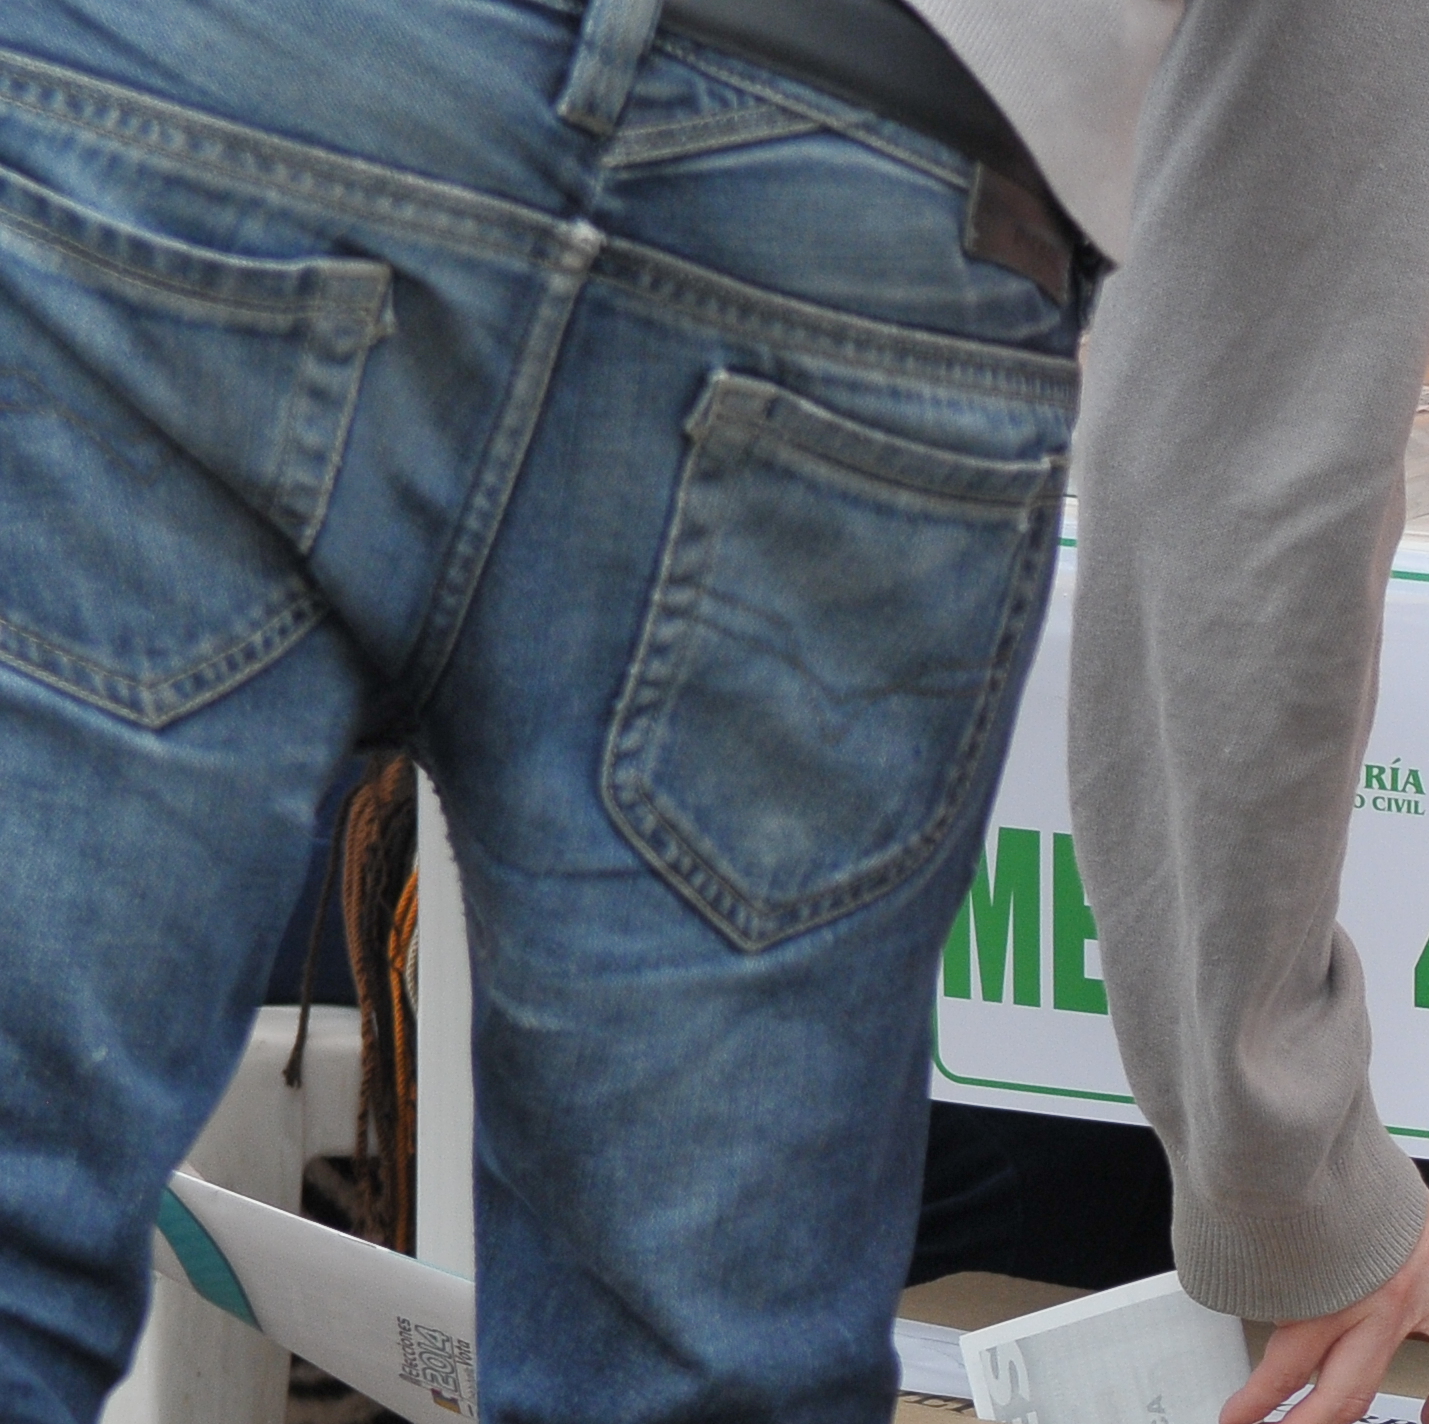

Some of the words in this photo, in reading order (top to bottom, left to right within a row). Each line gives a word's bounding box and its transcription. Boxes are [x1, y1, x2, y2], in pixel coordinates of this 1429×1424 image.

[1371, 795, 1426, 815] CIVIL
[942, 826, 1109, 1016] ME
[414, 1323, 459, 1393] 2014
